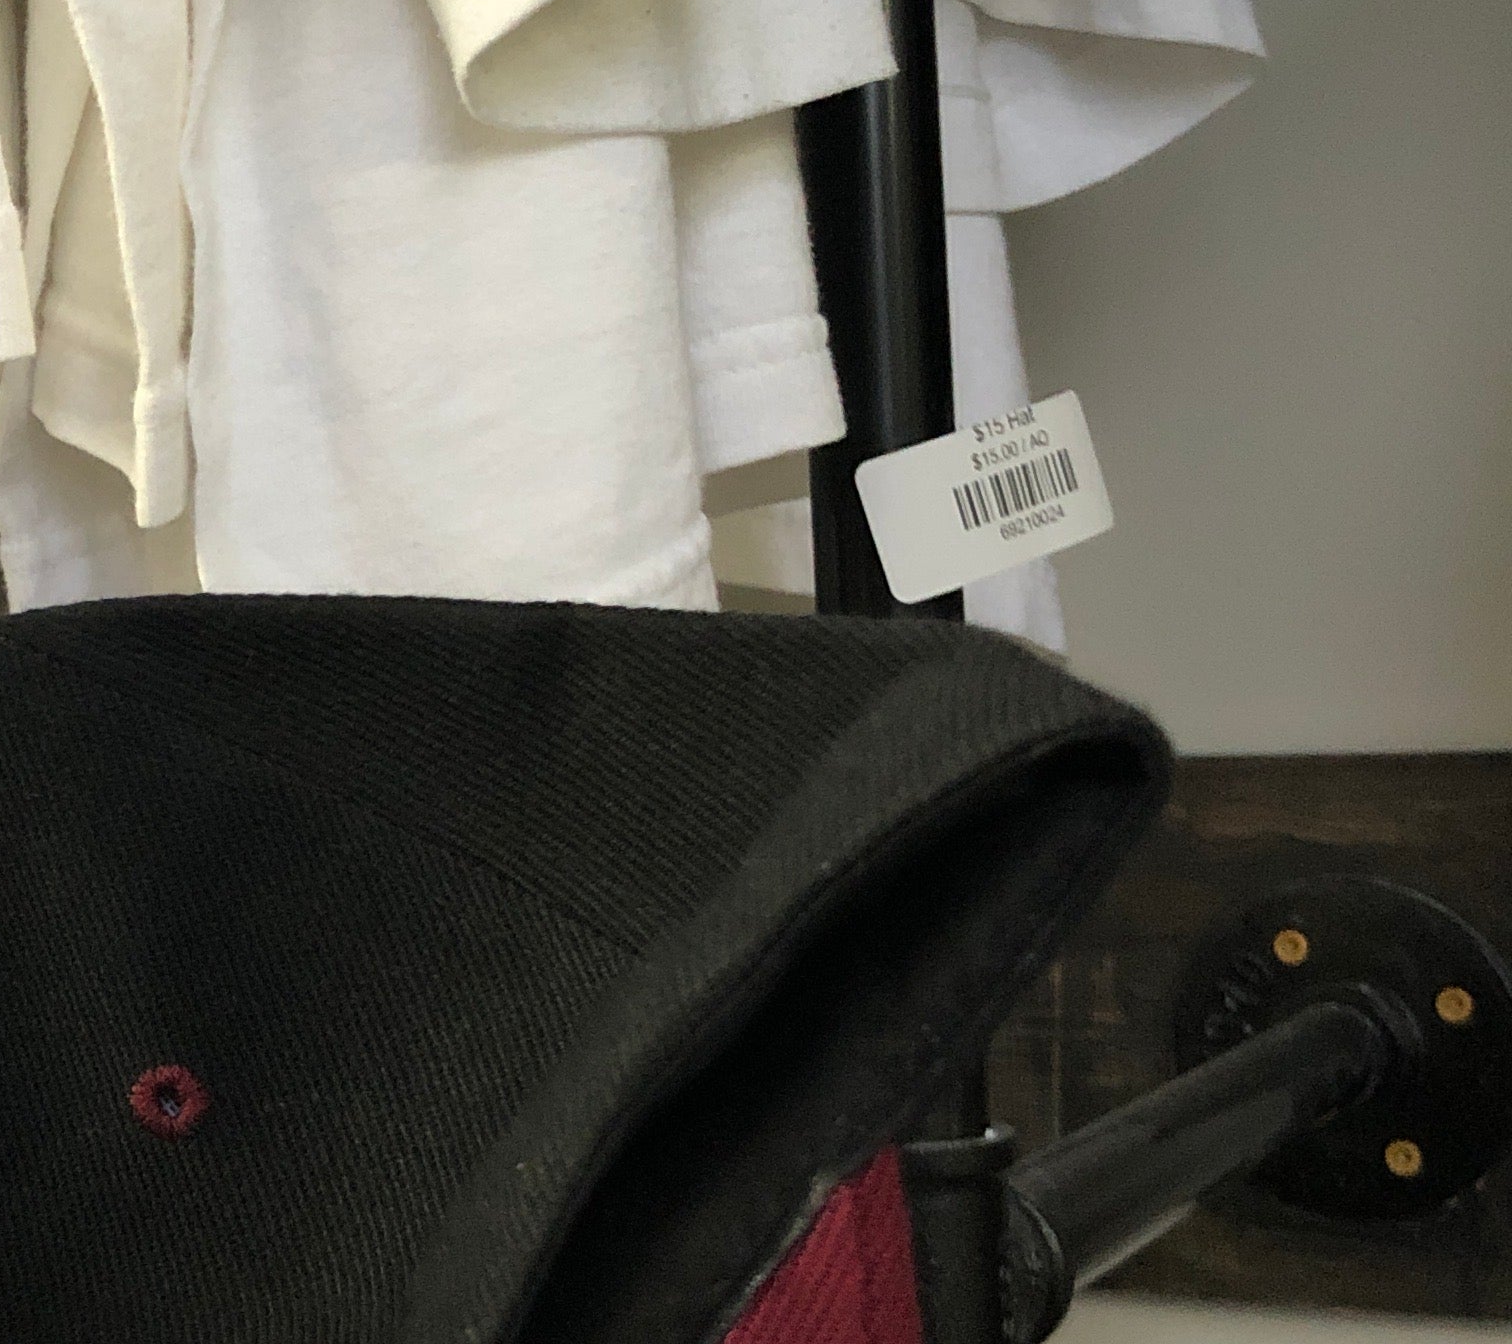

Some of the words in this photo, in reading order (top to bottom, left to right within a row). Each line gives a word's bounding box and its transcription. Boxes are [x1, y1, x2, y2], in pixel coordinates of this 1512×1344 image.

[971, 420, 1006, 443] $15
[1007, 404, 1036, 429] Hat
[971, 440, 1019, 470] $15.00
[1000, 503, 1065, 540] 69210024
